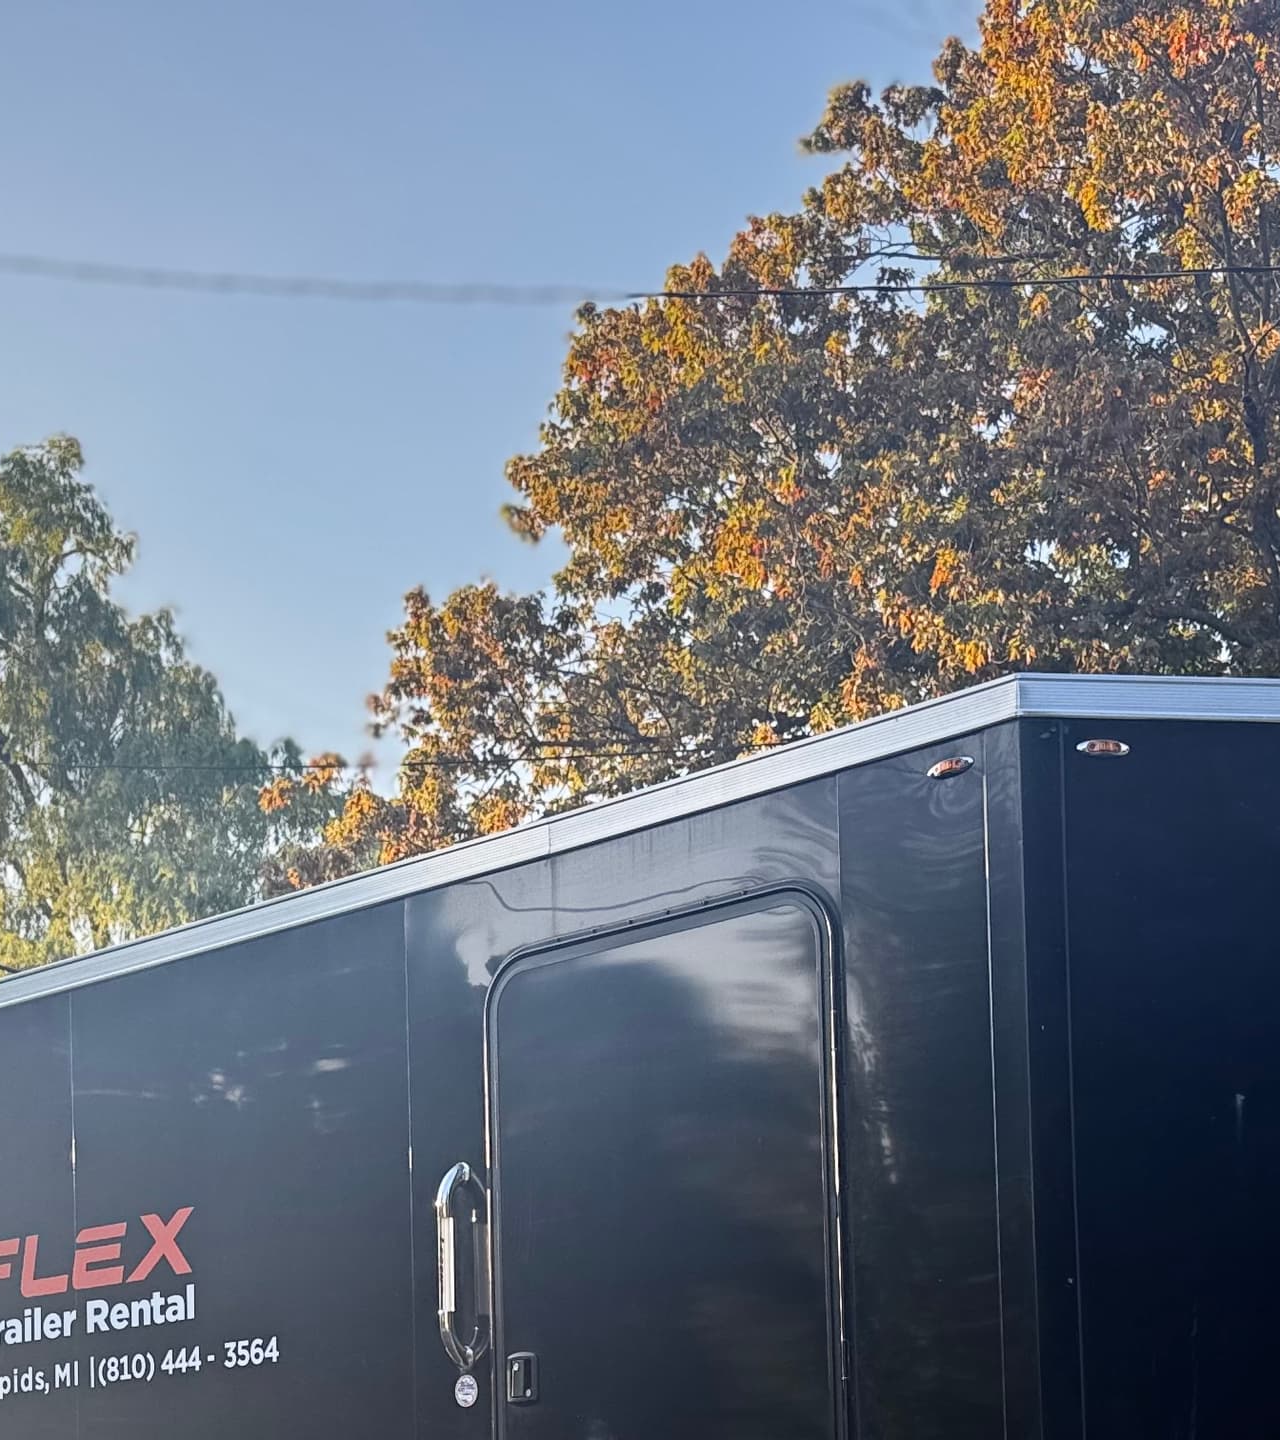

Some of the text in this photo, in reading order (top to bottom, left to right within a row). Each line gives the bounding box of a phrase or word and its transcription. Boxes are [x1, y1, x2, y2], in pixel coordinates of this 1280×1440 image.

[86, 1284, 195, 1333] Rental
[55, 1361, 79, 1388] MI
[161, 1346, 202, 1375] 444
[224, 1336, 279, 1368] 3564
